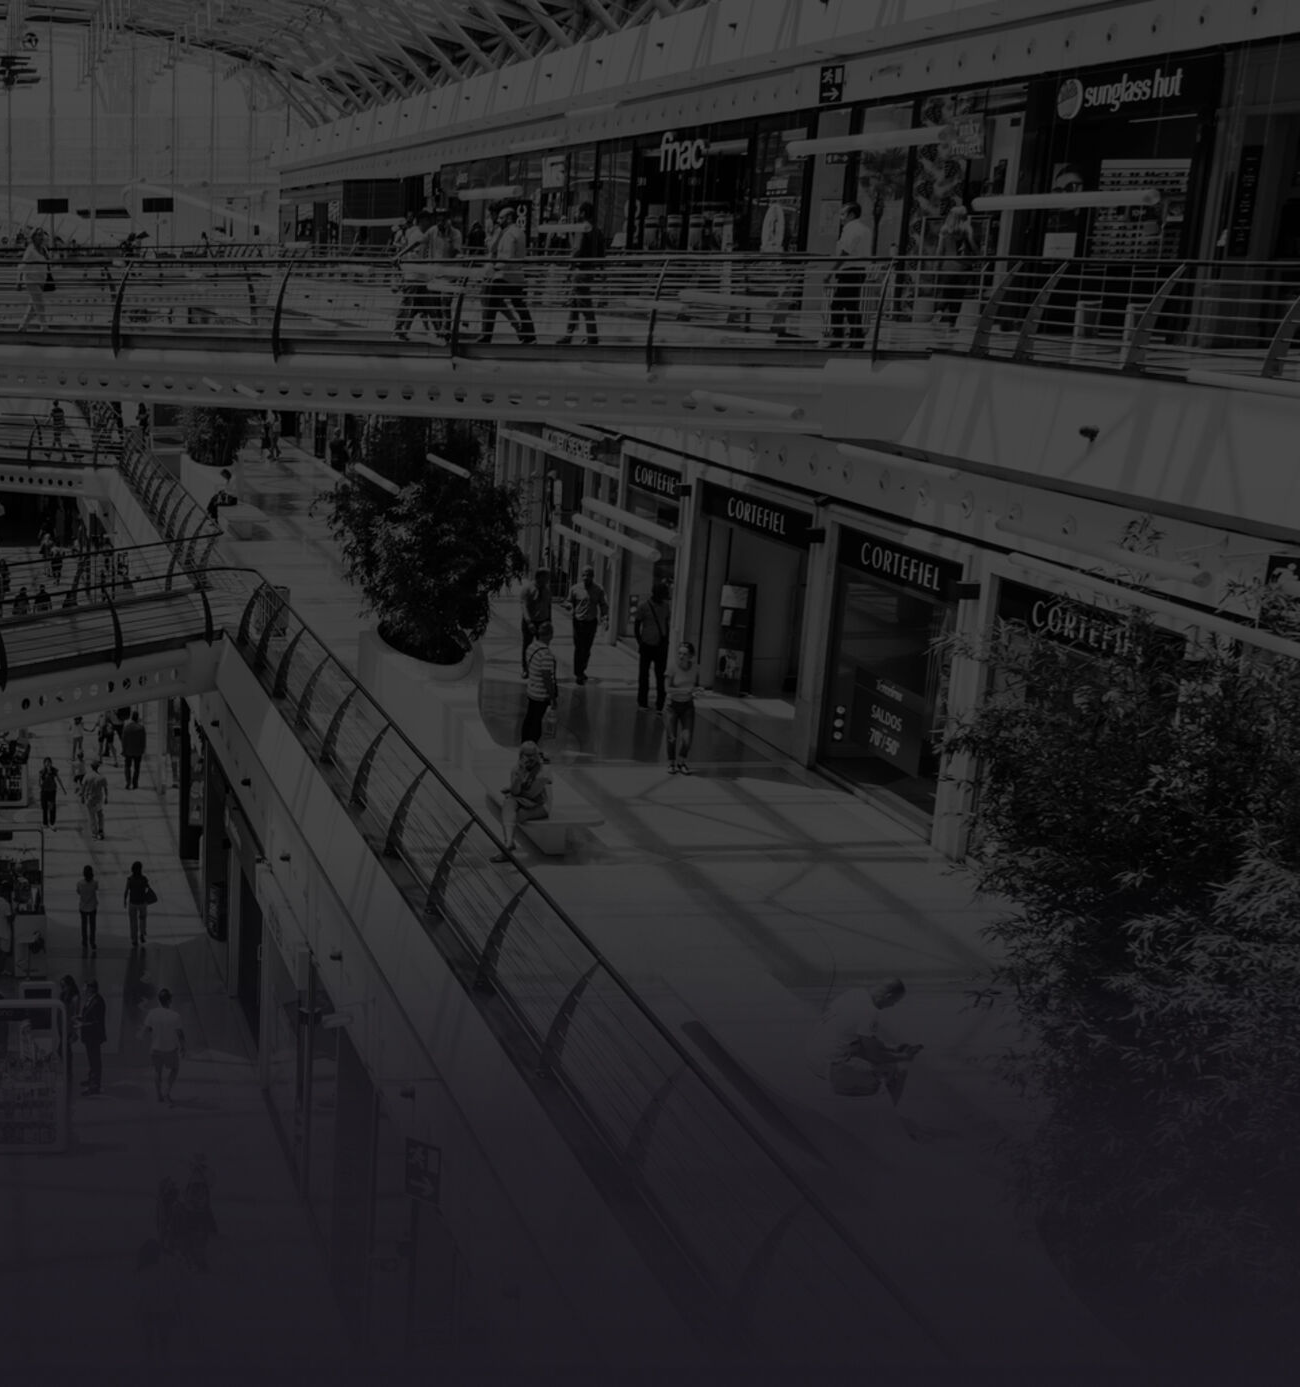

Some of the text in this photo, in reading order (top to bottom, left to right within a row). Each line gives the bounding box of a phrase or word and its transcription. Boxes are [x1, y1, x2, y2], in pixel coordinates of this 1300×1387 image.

[1084, 68, 1183, 112] sunglass hut
[659, 131, 705, 172] fnac
[634, 464, 679, 496] CORTEFIE
[727, 497, 786, 535] CORTEFIEL
[860, 542, 941, 591] CORTEFIEL
[1032, 600, 1136, 658] CORTEFIE
[871, 704, 902, 732] SALDOS
